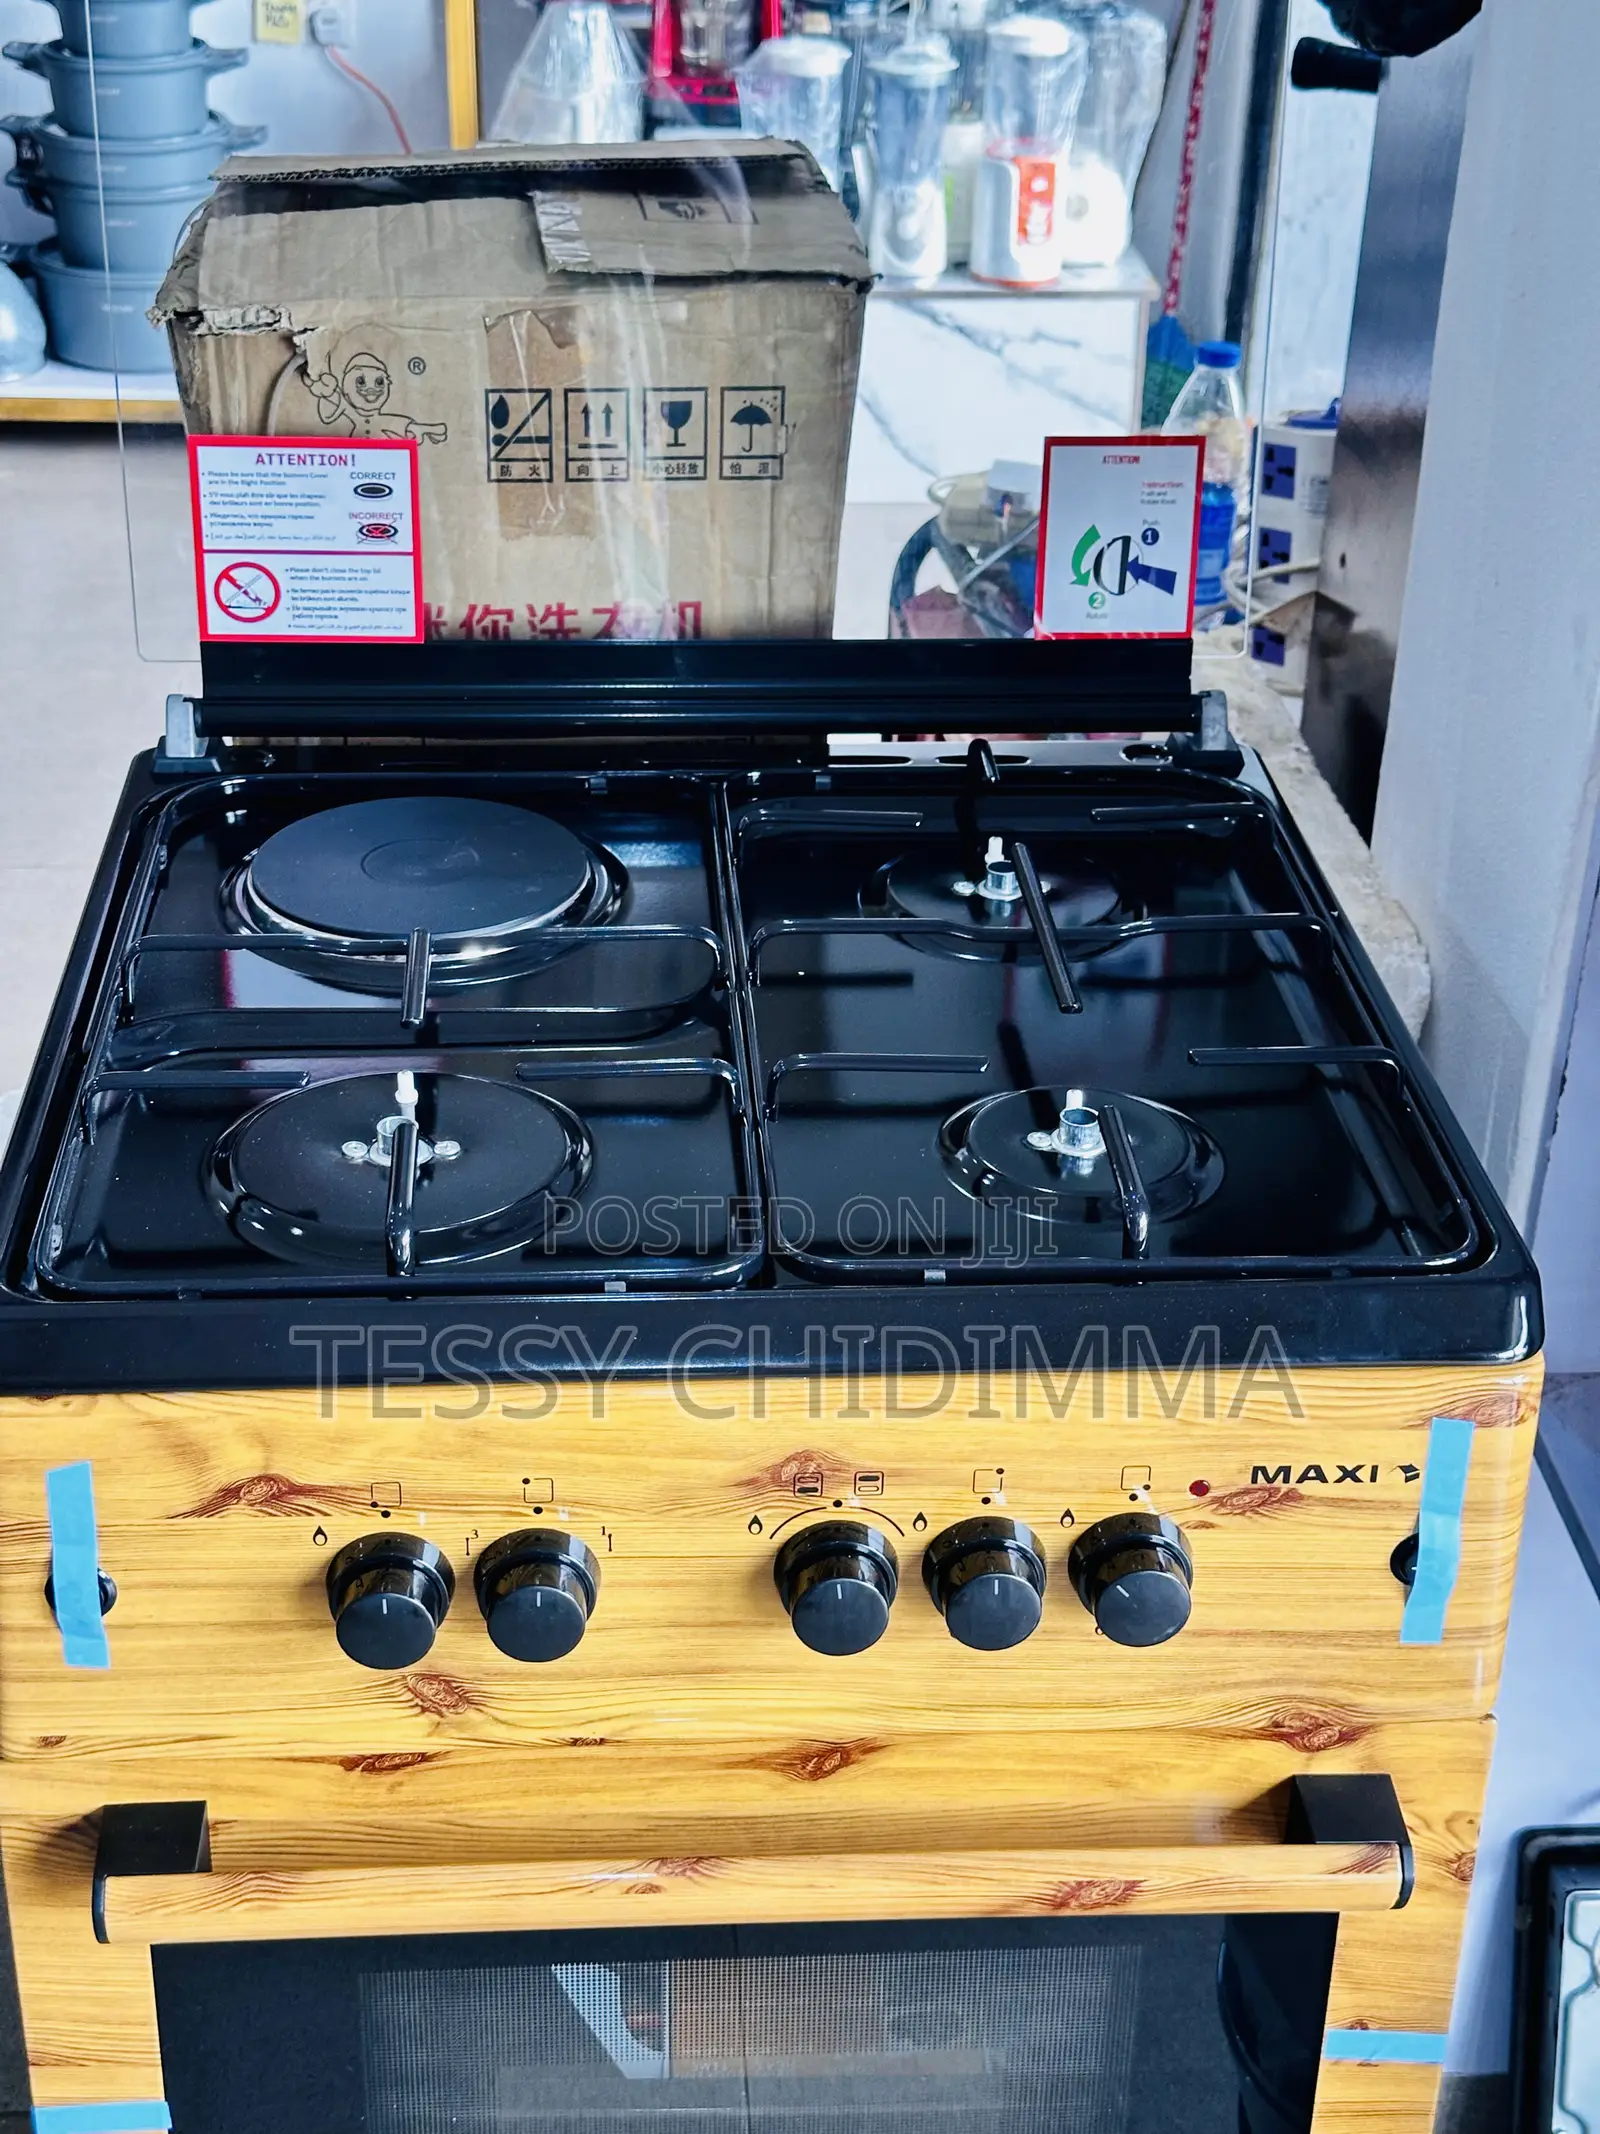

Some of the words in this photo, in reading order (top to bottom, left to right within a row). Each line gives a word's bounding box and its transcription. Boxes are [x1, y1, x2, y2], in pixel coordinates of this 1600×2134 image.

[255, 453, 356, 467] ATTENTION!
[350, 471, 396, 480] CORRECT
[500, 463, 541, 478] 防火
[577, 463, 620, 477] 向上
[349, 512, 403, 520] INCORRECT
[1250, 1464, 1379, 1484] MAXI
[470, 1529, 479, 1539] 3
